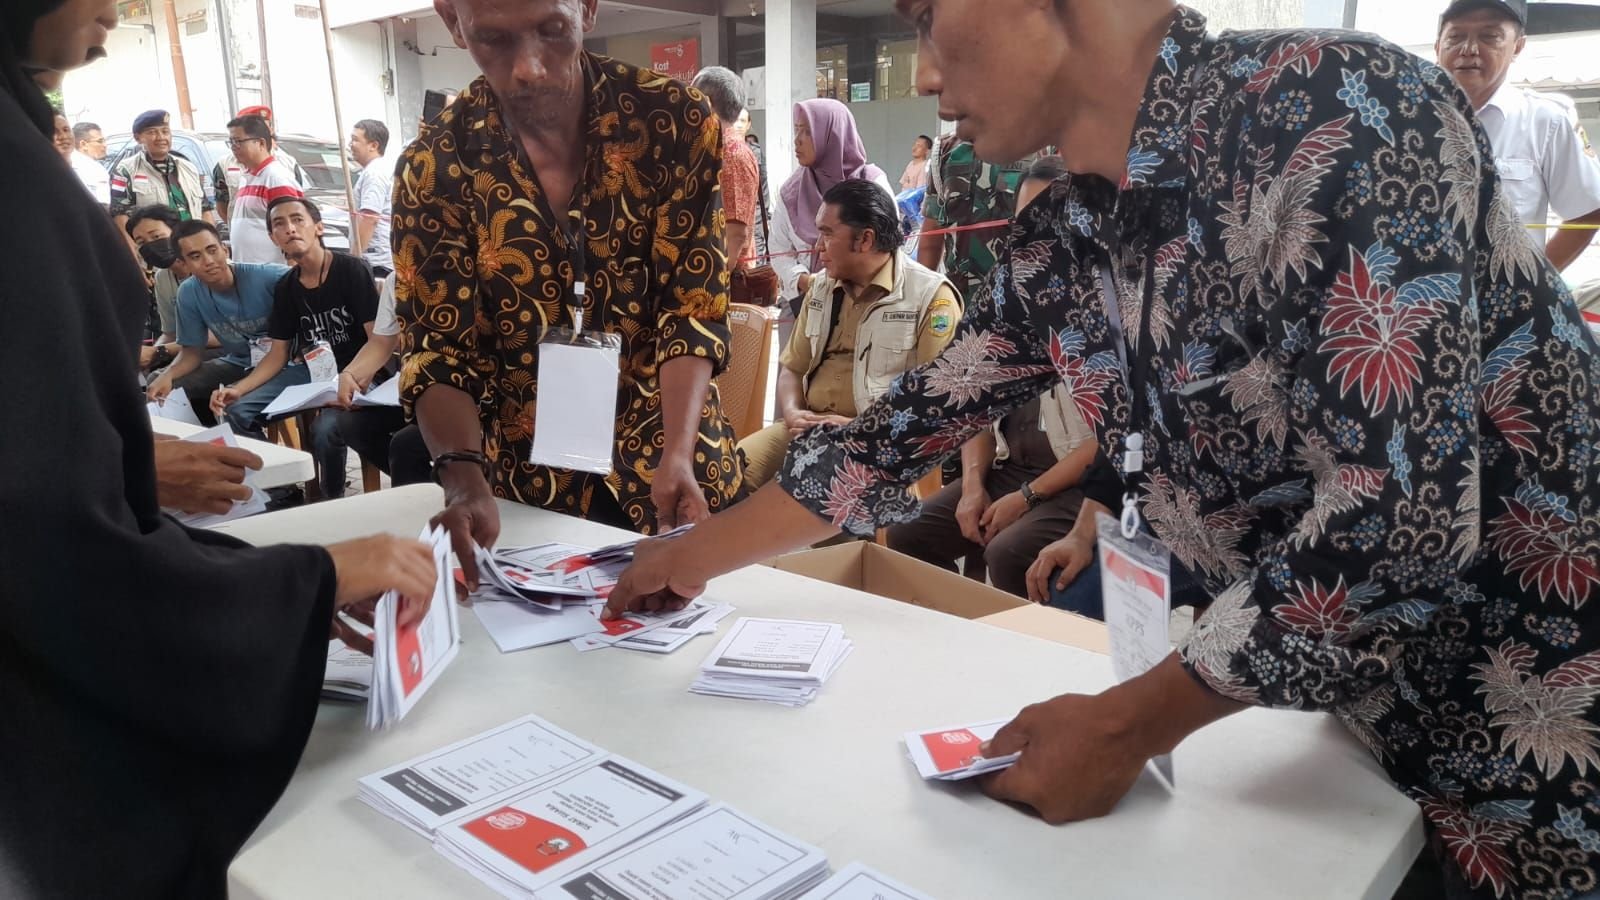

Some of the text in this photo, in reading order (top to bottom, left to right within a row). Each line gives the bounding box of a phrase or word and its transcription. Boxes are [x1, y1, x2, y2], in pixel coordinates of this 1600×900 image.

[653, 60, 669, 71] Kost
[300, 305, 354, 342] GUESS
[545, 803, 592, 831] SURAT SUARA
